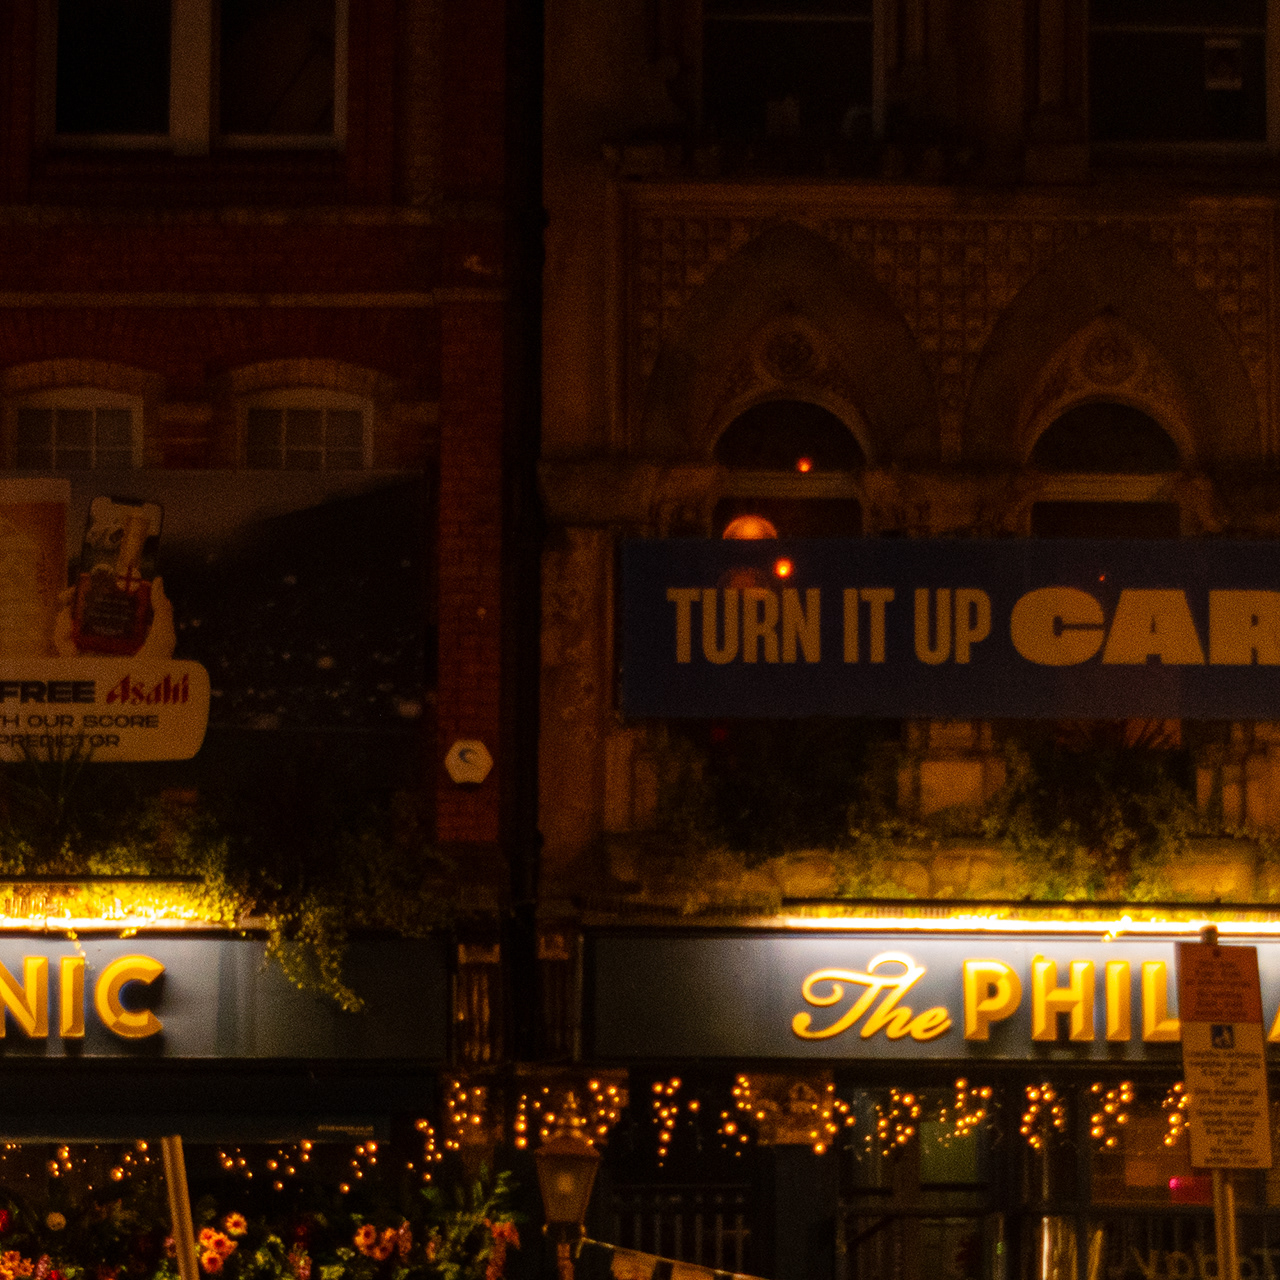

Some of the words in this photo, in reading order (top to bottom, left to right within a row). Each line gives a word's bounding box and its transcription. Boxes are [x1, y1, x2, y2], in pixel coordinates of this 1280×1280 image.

[666, 587, 823, 665] TURN
[842, 587, 896, 665] IT
[914, 588, 993, 665] UP
[105, 673, 190, 705] Asahi
[26, 714, 75, 728] OUR
[82, 714, 159, 728] SCORE
[790, 949, 953, 1042] The
